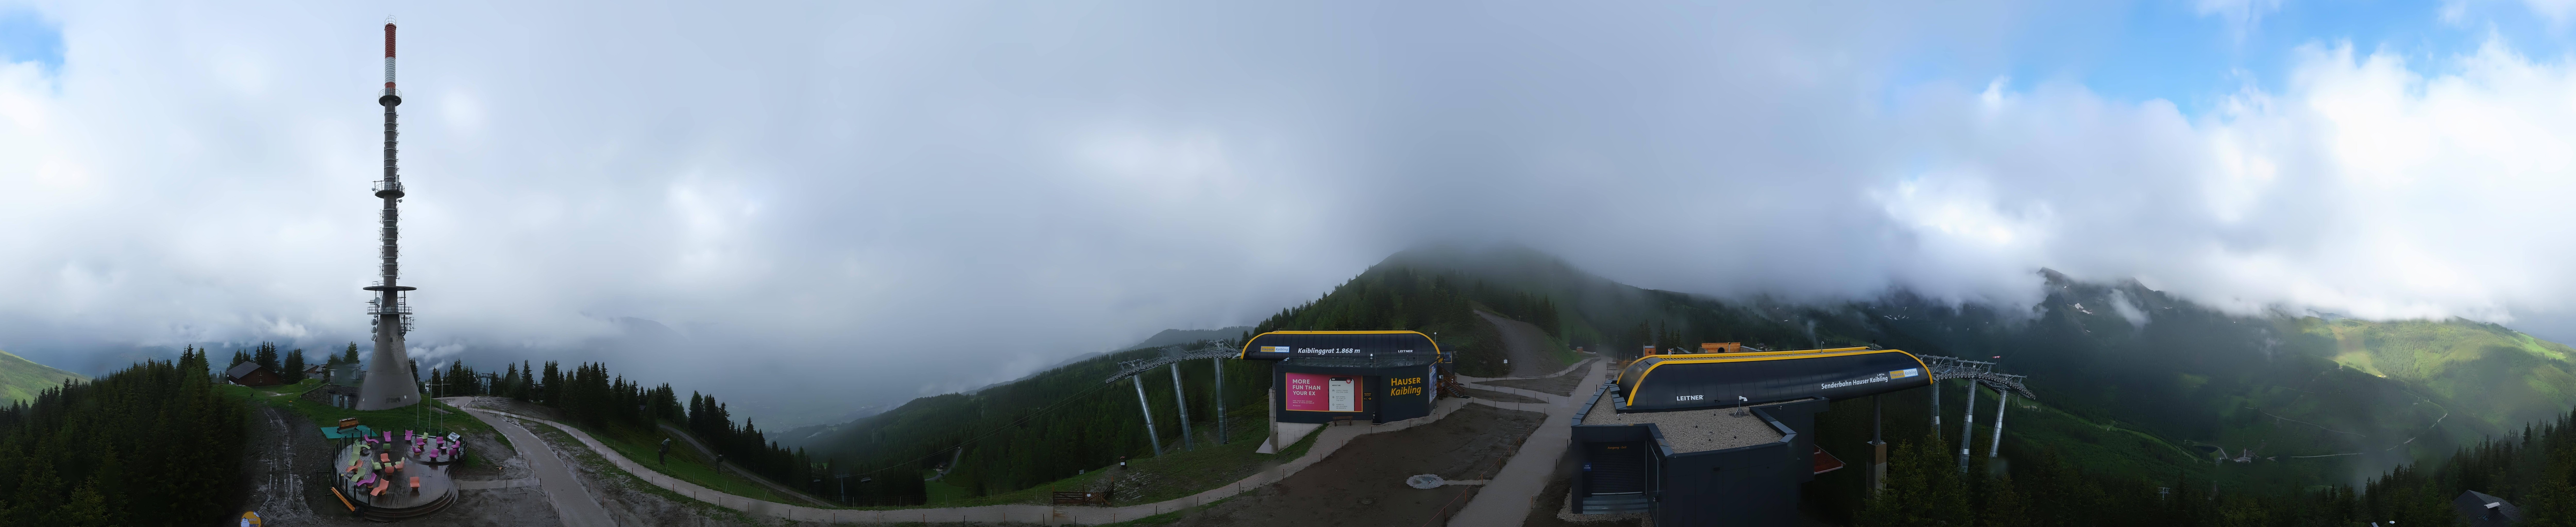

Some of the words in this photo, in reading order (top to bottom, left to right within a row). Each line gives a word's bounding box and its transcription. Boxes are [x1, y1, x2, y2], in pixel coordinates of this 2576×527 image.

[1391, 377, 1421, 386] HAUSER
[1821, 381, 1852, 389] Senderbahn
[1391, 386, 1421, 396] Kaibling
